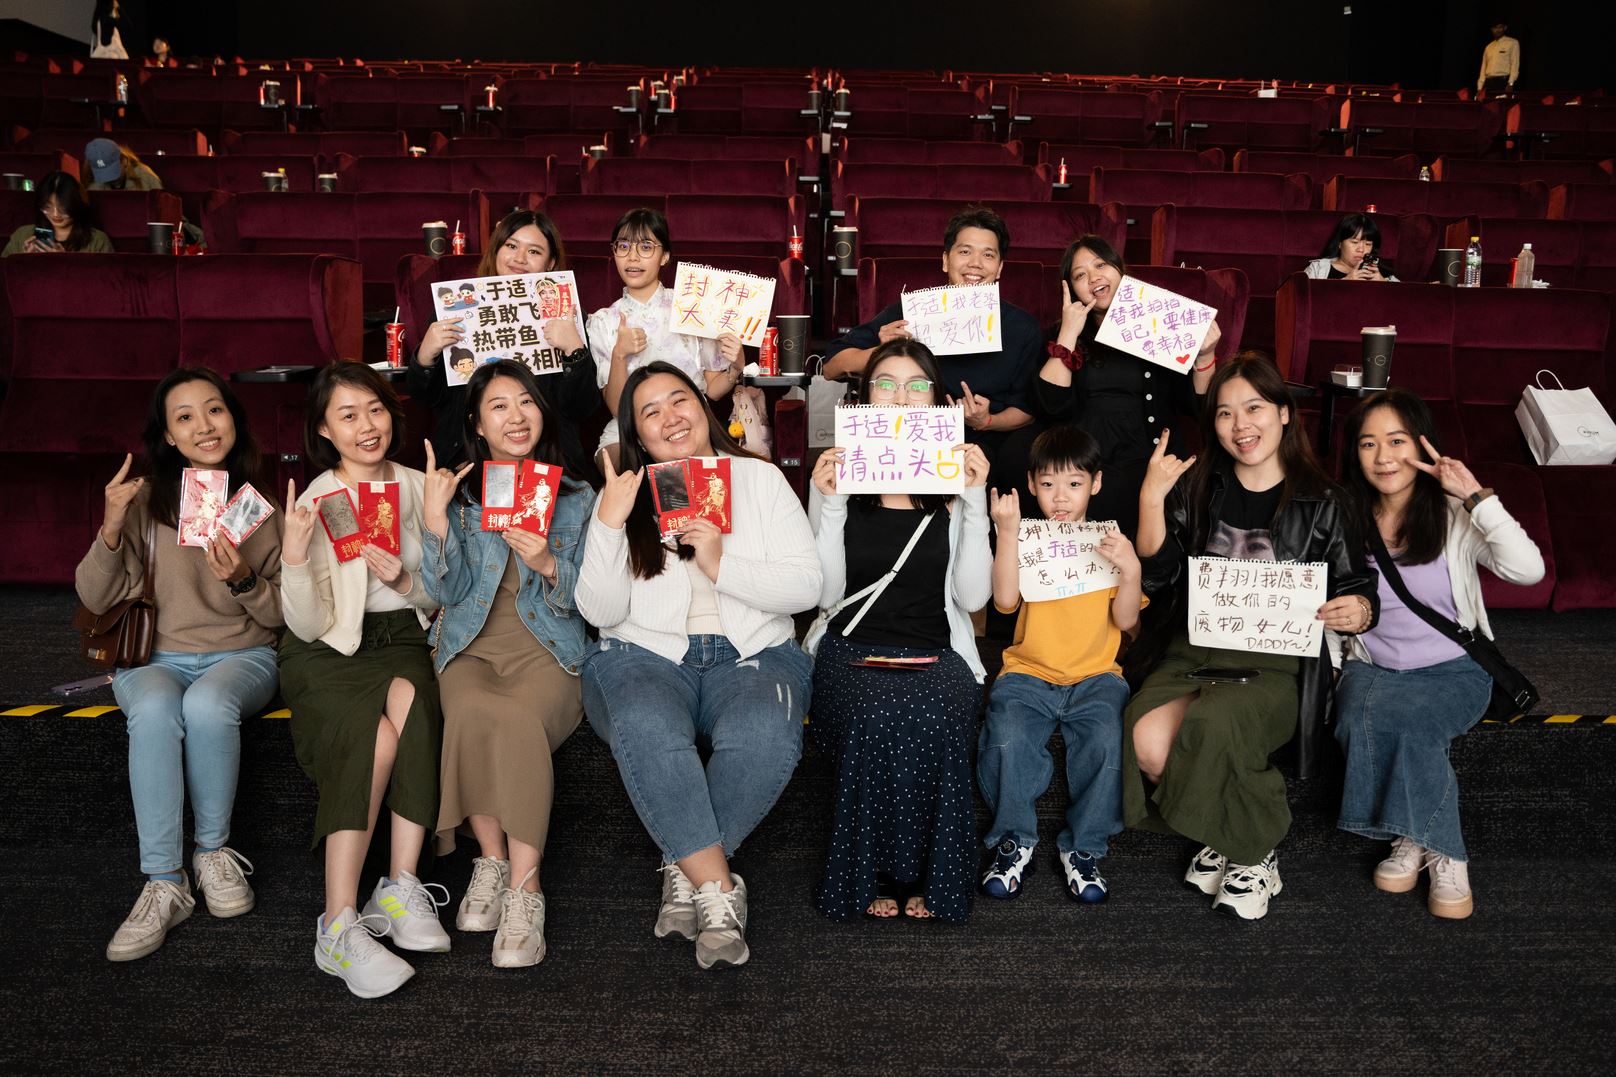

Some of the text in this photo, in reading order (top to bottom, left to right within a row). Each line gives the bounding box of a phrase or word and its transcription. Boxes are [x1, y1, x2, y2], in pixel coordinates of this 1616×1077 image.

[487, 279, 528, 301] 于适
[682, 273, 750, 305] 封神
[1118, 284, 1145, 302] 适!
[478, 302, 541, 327] 勇敢飞
[473, 325, 540, 353] 热带鱼
[843, 412, 956, 442] 于适!爱我
[839, 445, 935, 482] 请点头
[1212, 592, 1291, 610] 做你的
